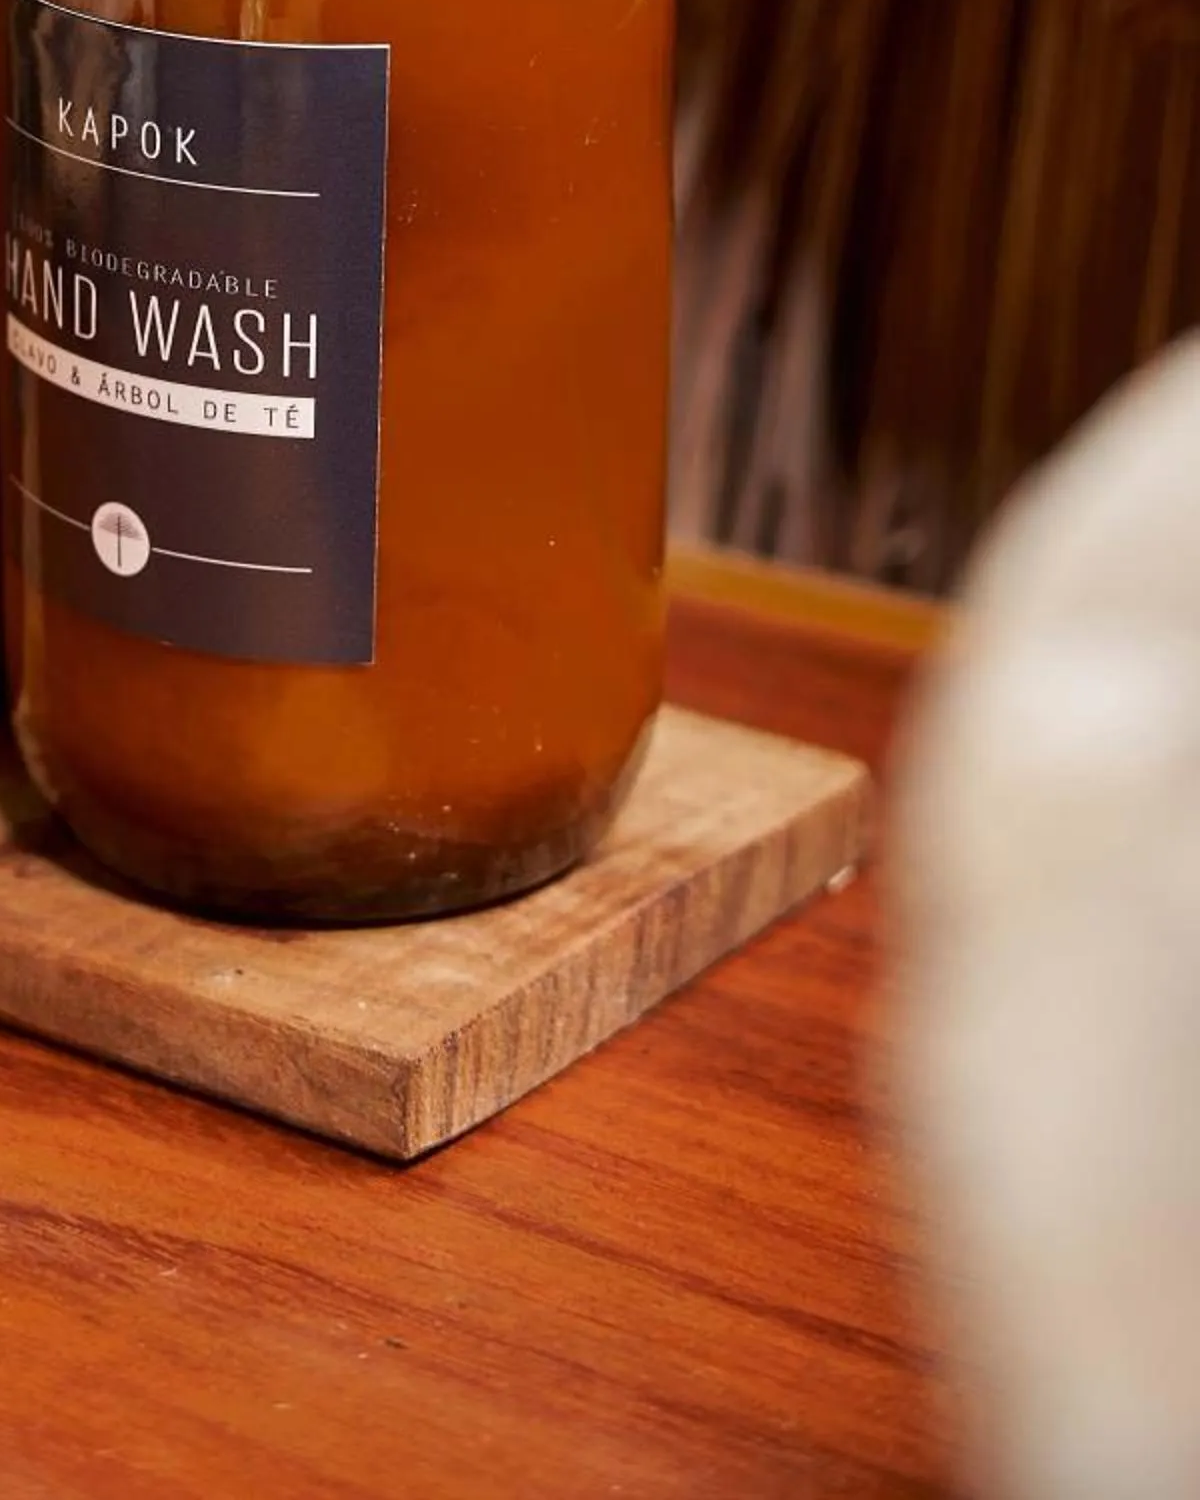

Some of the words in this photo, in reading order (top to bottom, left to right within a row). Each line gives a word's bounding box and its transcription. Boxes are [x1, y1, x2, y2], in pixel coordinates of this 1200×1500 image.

[58, 97, 198, 166] KAPOK
[66, 238, 279, 299] BIODEGRADABLE
[5, 231, 97, 340] HAND
[129, 289, 317, 379] WASH
[71, 365, 81, 386] &
[97, 372, 180, 415] ÁRBOL
[202, 400, 237, 423] DE
[263, 404, 300, 429] TÉ
